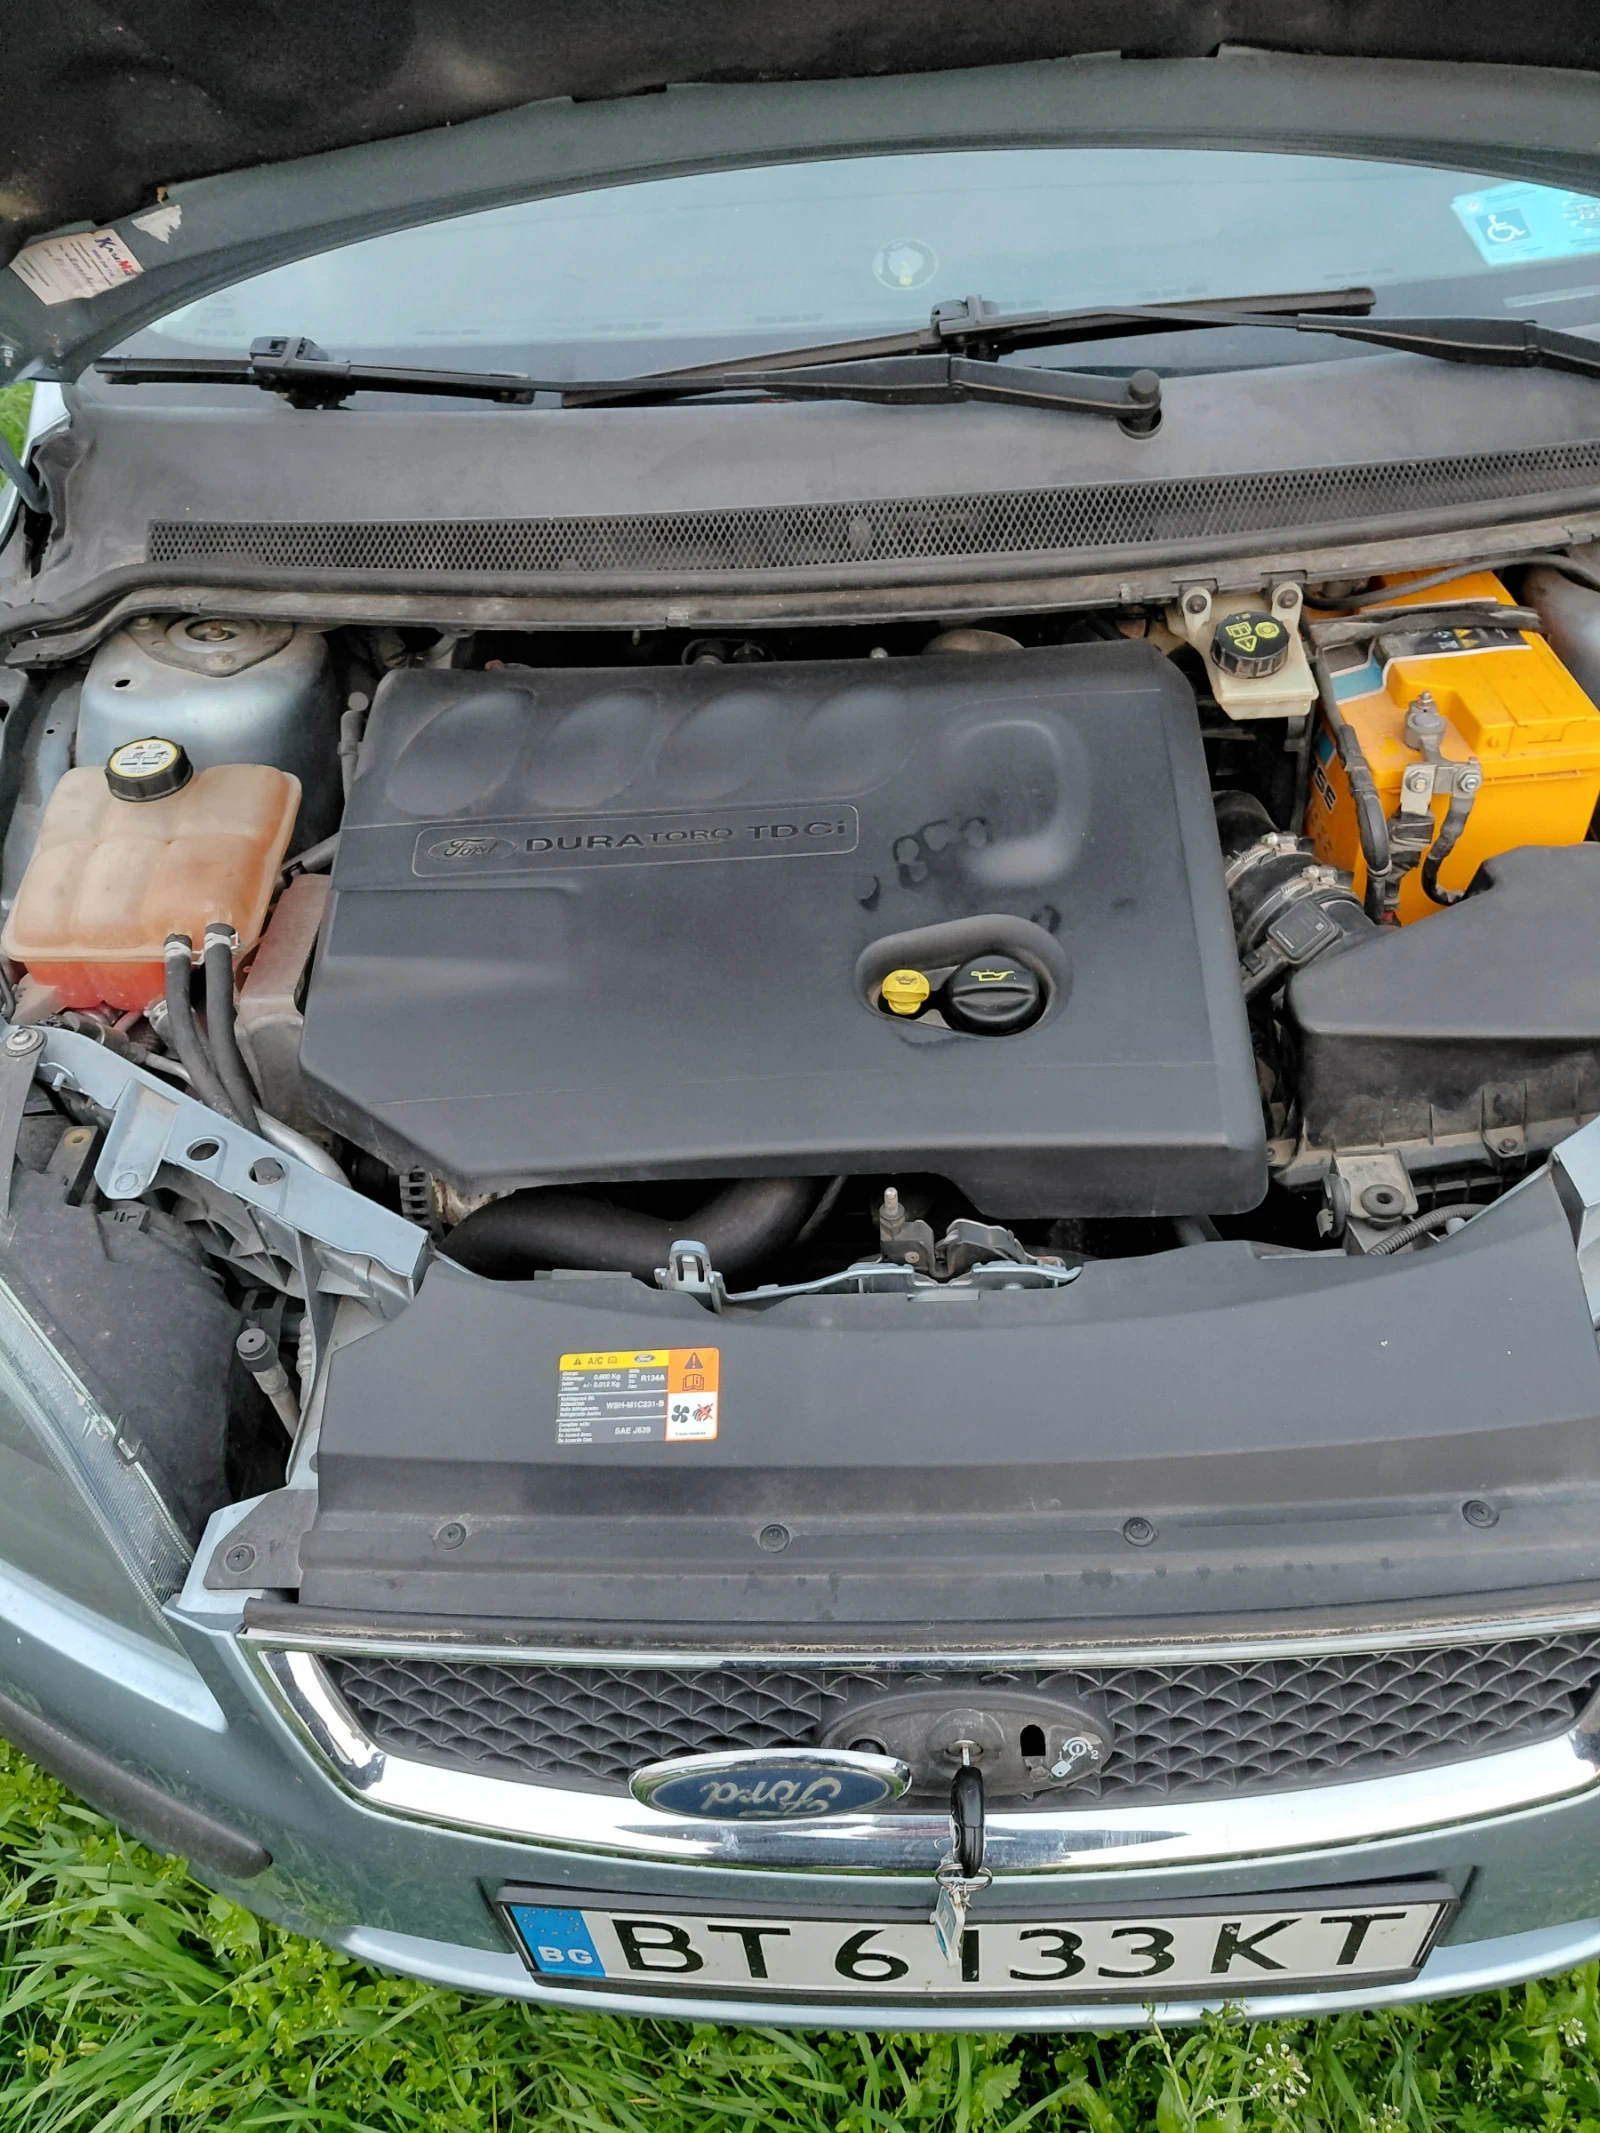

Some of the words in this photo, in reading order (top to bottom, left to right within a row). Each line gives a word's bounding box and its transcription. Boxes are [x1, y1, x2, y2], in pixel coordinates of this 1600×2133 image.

[444, 837, 498, 857] Ford
[747, 820, 846, 840] TDCi
[588, 1357, 604, 1365] A/C
[640, 1374, 665, 1382] R134A
[614, 1427, 631, 1435] SAE
[1090, 1749, 1099, 1760] 2
[700, 1776, 842, 1817] Ford
[611, 1919, 791, 1979] BT
[1210, 1912, 1407, 1974] KT
[537, 1946, 593, 1964] BG
